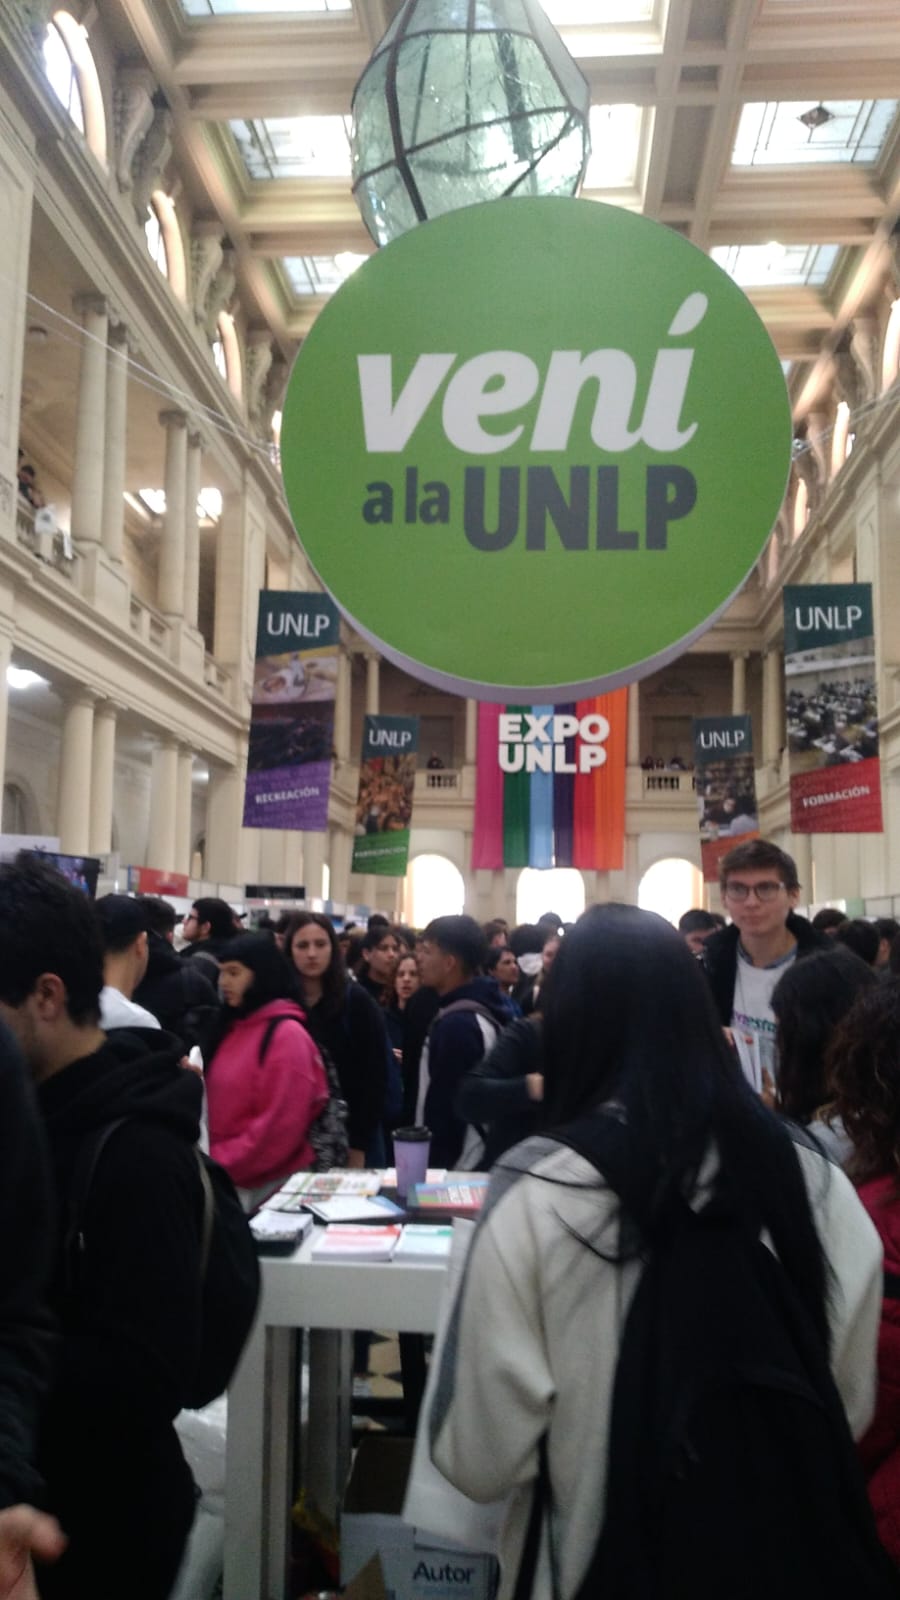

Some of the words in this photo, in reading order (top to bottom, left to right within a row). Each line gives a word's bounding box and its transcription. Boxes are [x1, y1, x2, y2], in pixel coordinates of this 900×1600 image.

[362, 480, 394, 525] a
[404, 466, 451, 525] la
[463, 464, 698, 552] UNLP
[266, 611, 330, 638] UNLP
[793, 605, 862, 631] UNLP
[368, 729, 412, 747] UNLP
[497, 713, 611, 744] EXPO
[699, 730, 745, 749] UNLP
[497, 742, 608, 775] UNLP
[255, 786, 319, 804] RECREACIÓN
[802, 784, 870, 808] FORMACIÓN
[412, 1560, 475, 1584] Autor
